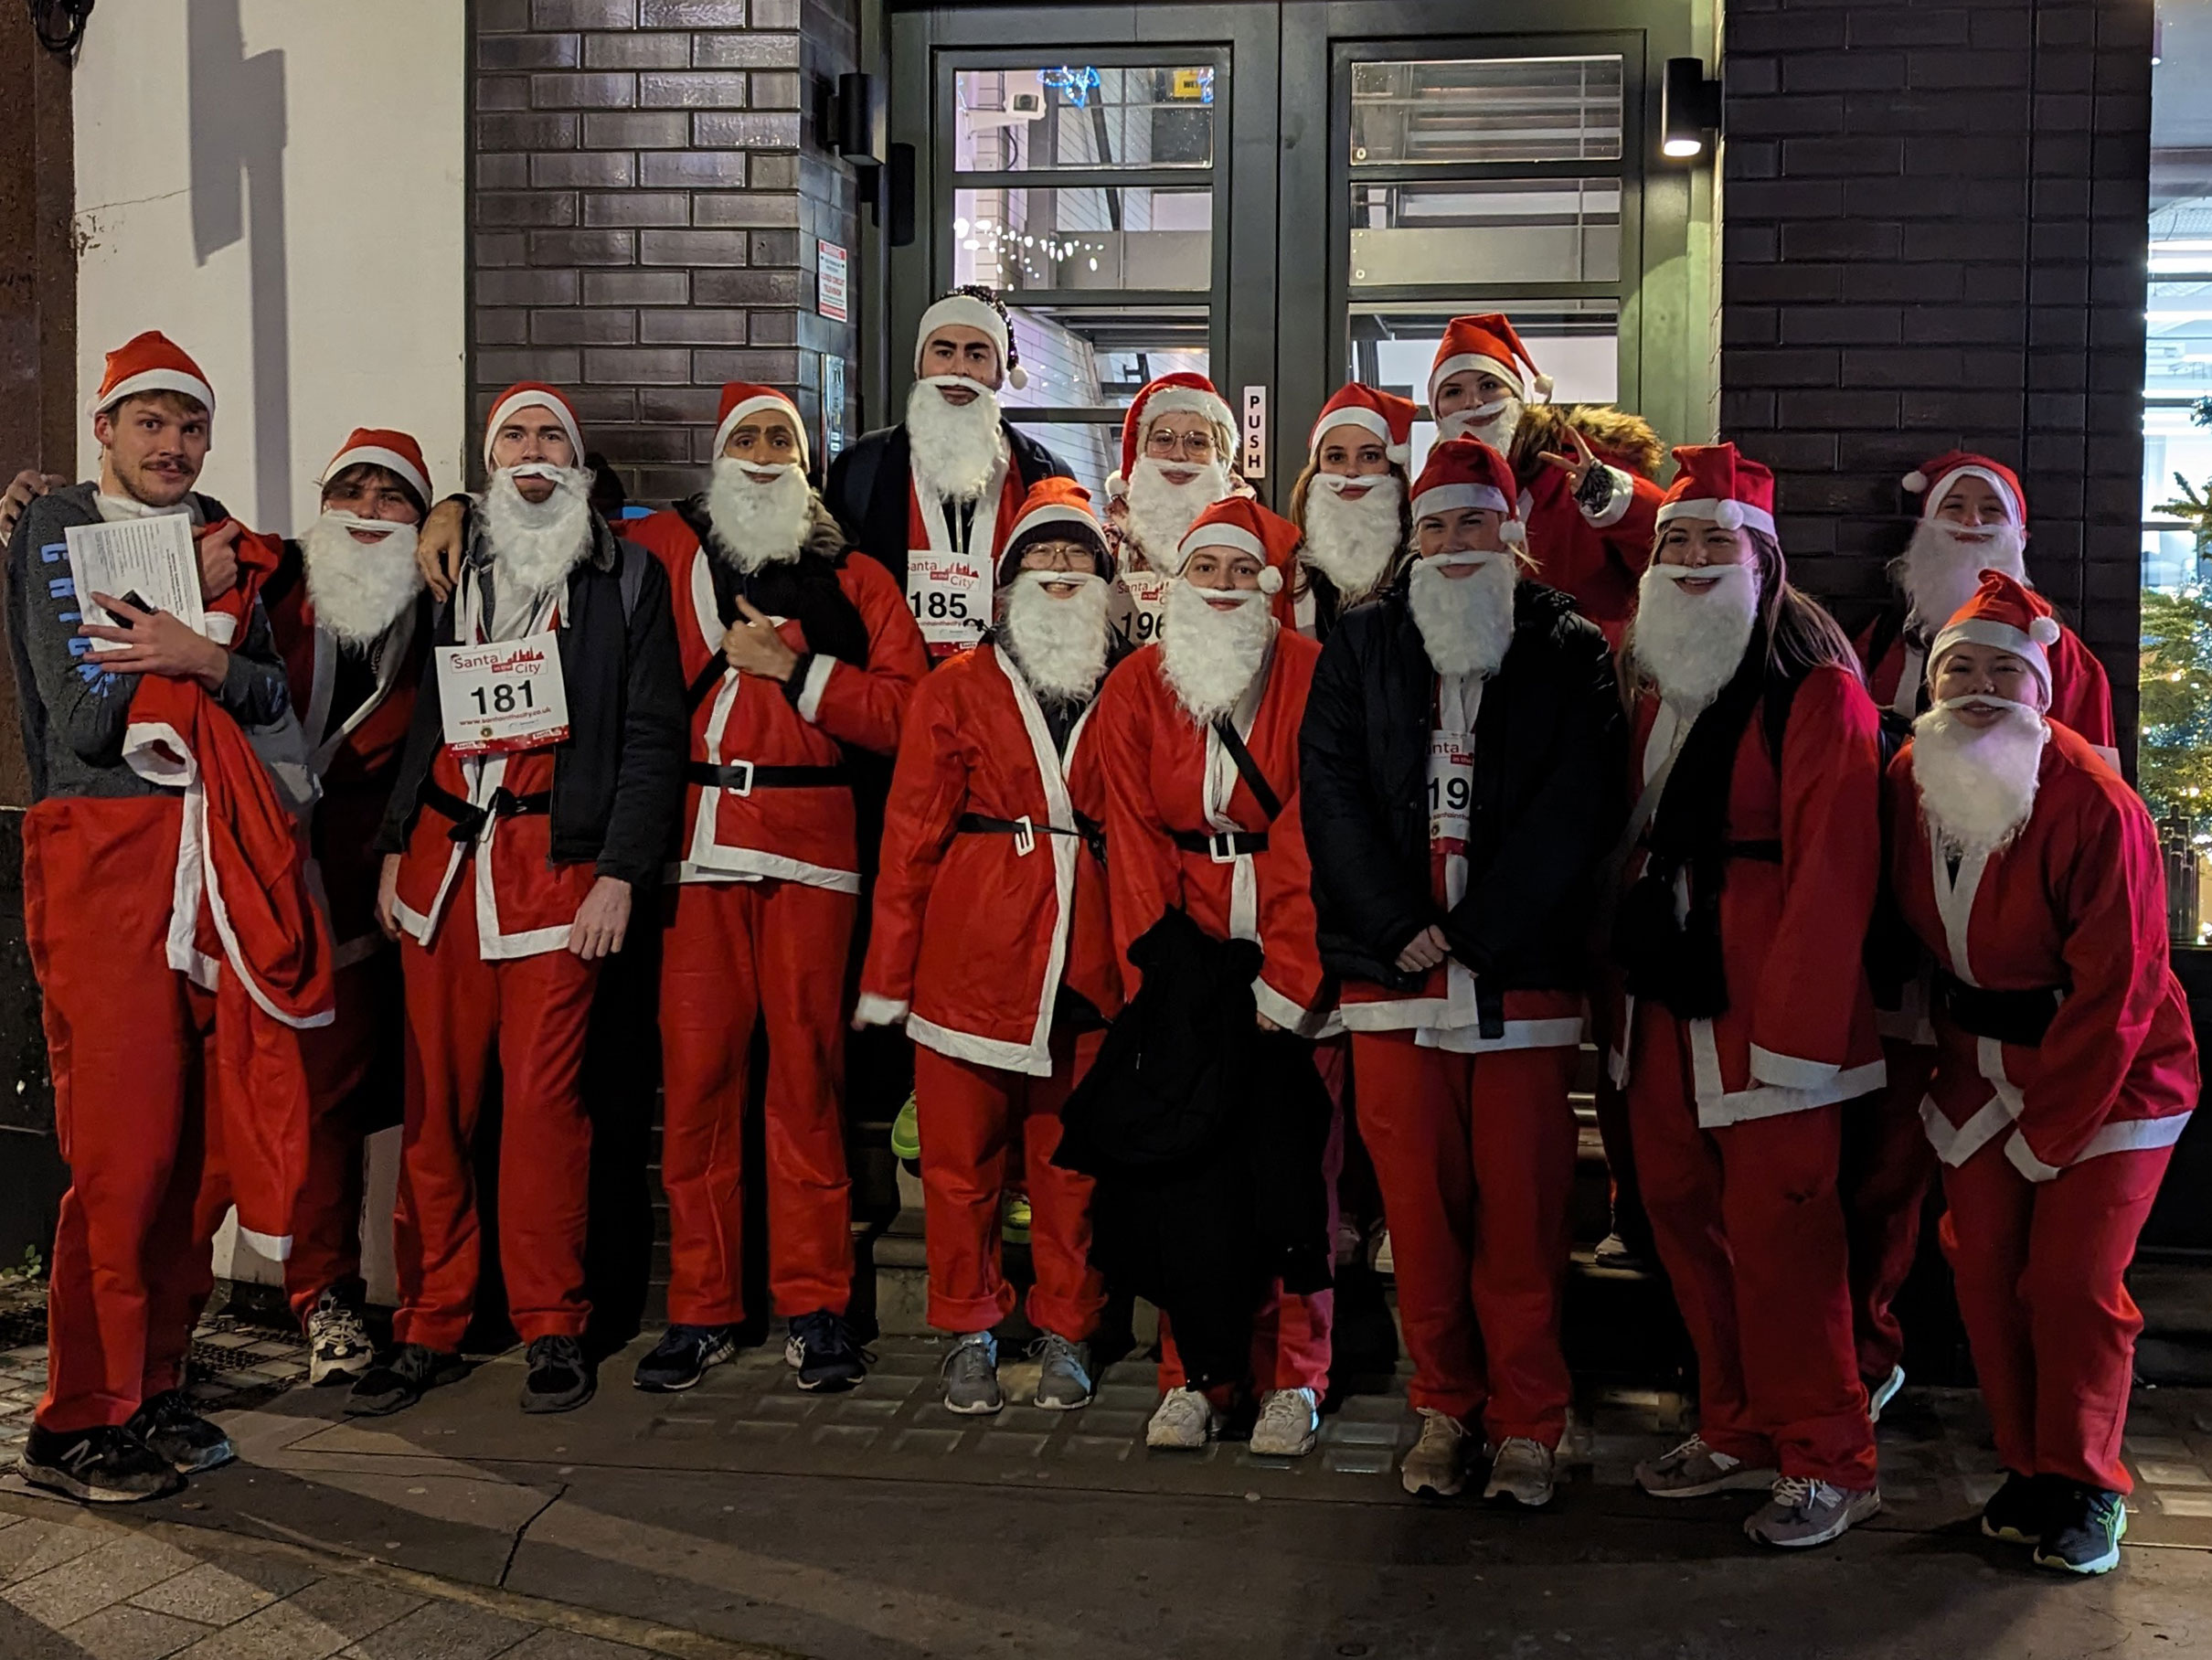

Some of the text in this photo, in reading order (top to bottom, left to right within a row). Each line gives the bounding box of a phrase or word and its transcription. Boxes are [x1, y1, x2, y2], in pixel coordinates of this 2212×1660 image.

[1248, 395, 1260, 468] PUSH
[907, 560, 938, 571] anta
[950, 575, 974, 590] City
[1117, 580, 1149, 594] Santa
[910, 591, 968, 619] 185
[453, 654, 498, 669] Santa
[515, 663, 540, 675] City
[471, 679, 533, 715] 181
[1427, 742, 1460, 753] nta
